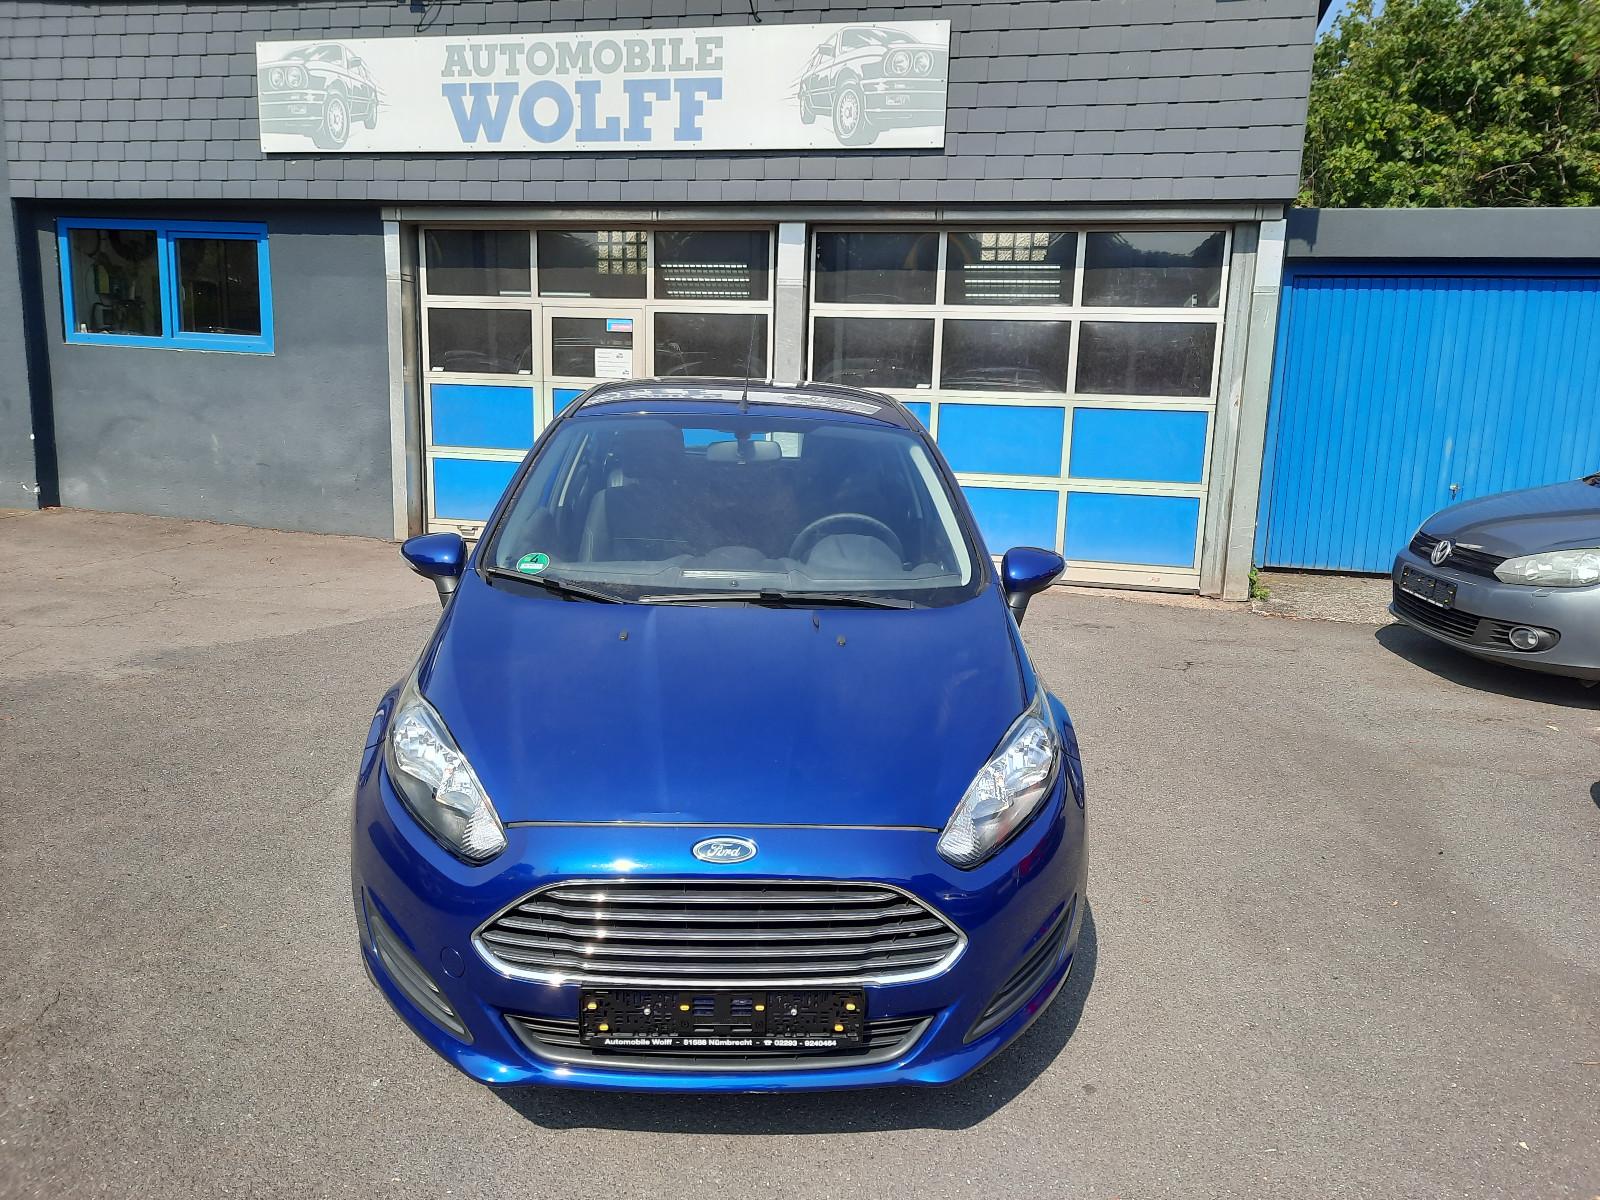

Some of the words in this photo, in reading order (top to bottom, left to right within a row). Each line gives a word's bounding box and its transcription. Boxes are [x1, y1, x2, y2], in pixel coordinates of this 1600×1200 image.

[441, 36, 723, 77] AUTOMOBILE
[441, 77, 723, 144] WOLFF
[707, 843, 742, 857] Ford
[604, 1038, 651, 1046] Automobile
[651, 1038, 673, 1046] Wolff
[708, 1038, 753, 1046] Nümbrecht
